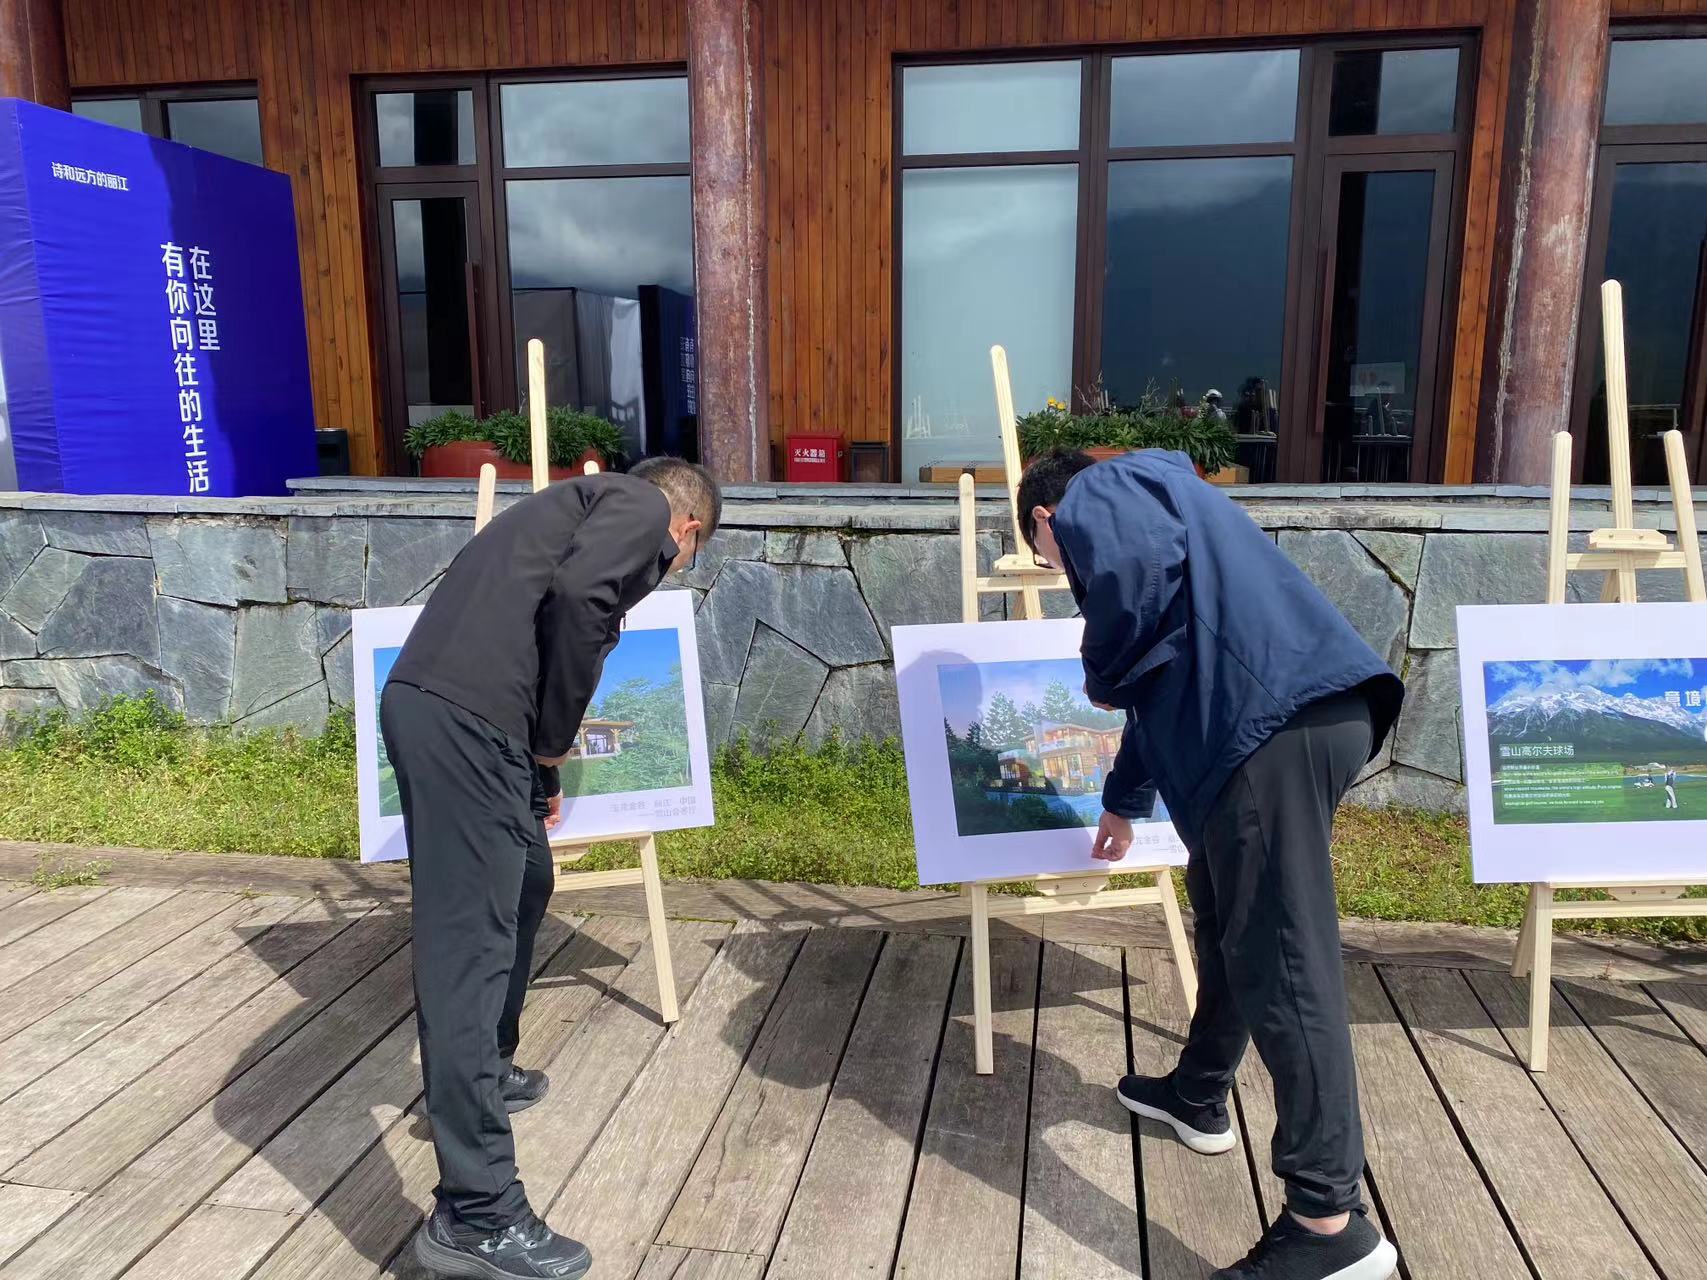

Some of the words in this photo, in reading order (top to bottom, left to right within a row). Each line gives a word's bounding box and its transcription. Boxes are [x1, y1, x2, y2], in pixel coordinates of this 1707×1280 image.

[51, 161, 129, 192] 诗和远方的丽江
[189, 245, 221, 352] 在这里
[160, 241, 210, 494] 有你向往的生活
[1663, 690, 1707, 708] 意境
[1499, 744, 1575, 758] 雪山高尔夫球场
